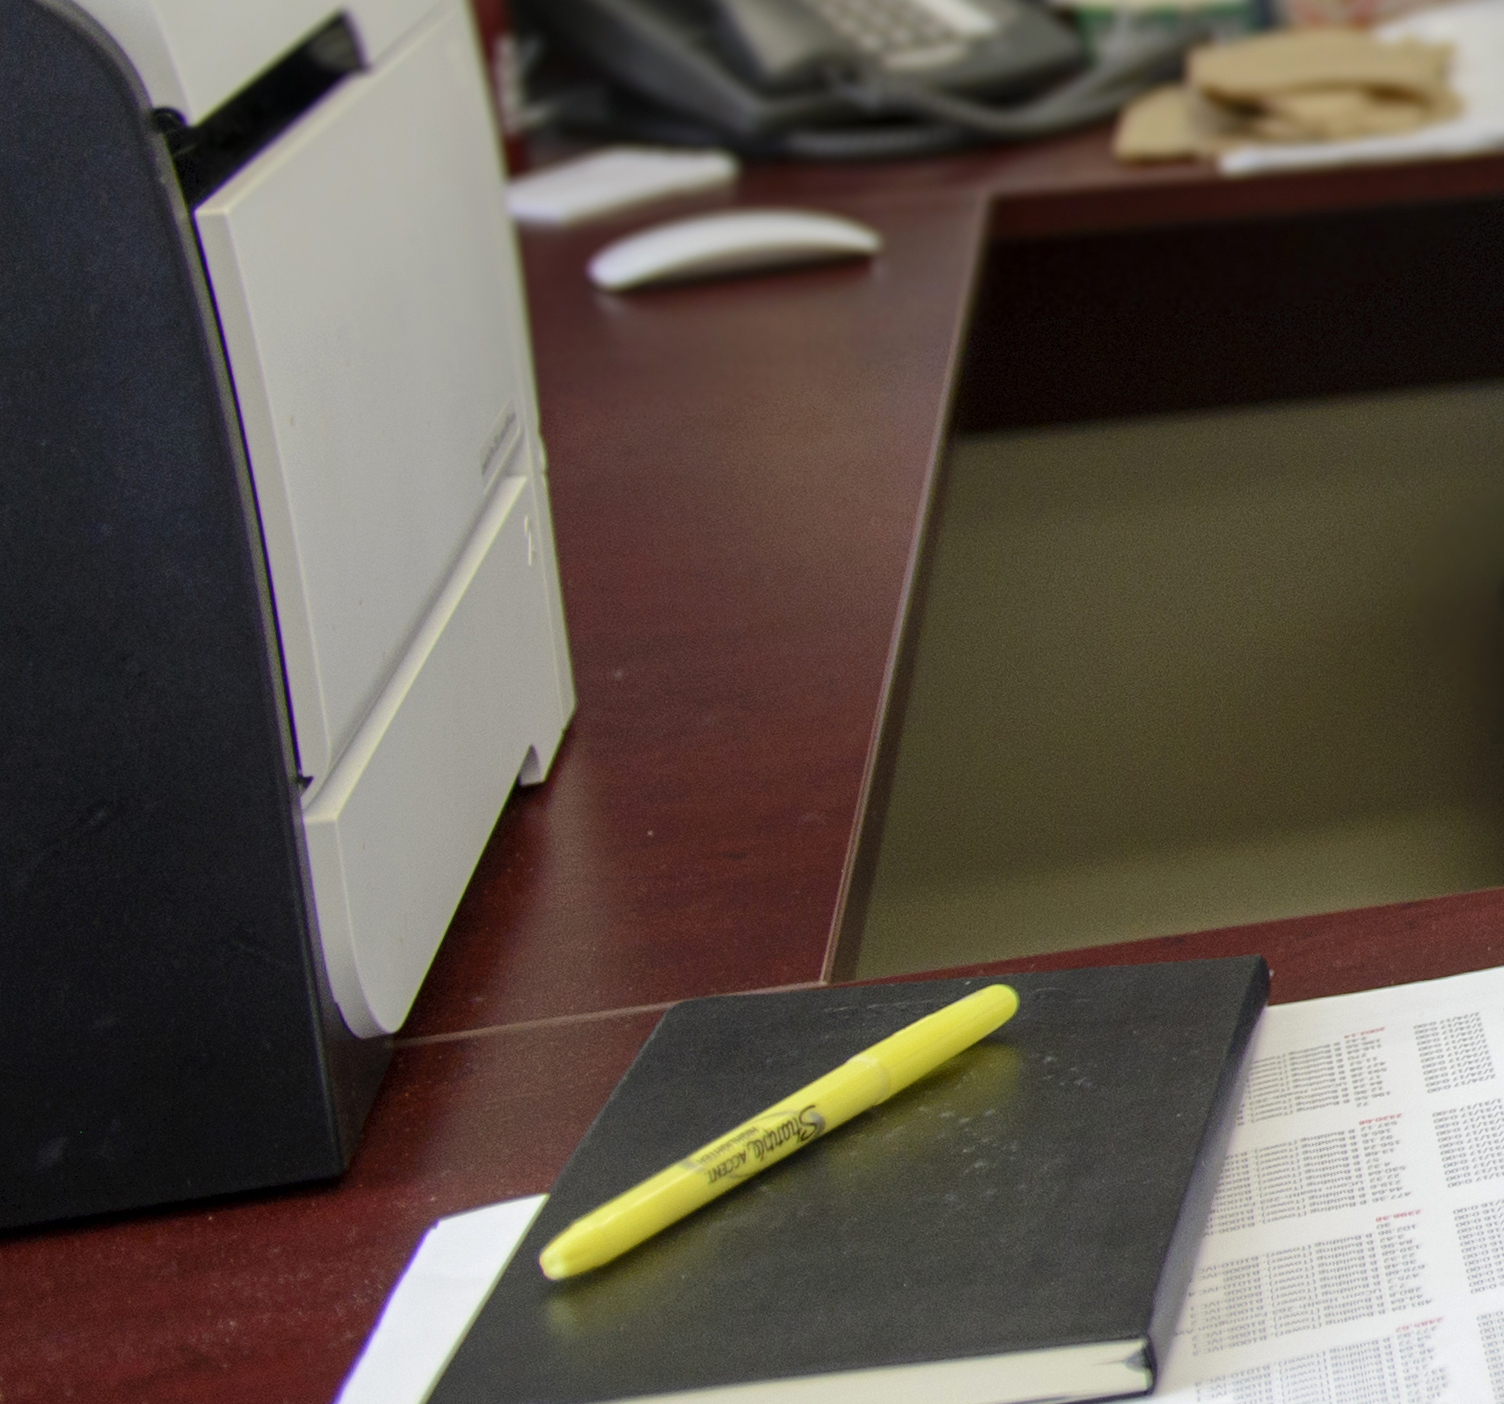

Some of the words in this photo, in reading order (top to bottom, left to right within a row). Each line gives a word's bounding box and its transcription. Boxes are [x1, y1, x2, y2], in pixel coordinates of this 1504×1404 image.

[696, 1127, 758, 1164] HIGHLIGHTER
[747, 1104, 817, 1161] Sharpie
[706, 1149, 747, 1184] ACCENT
